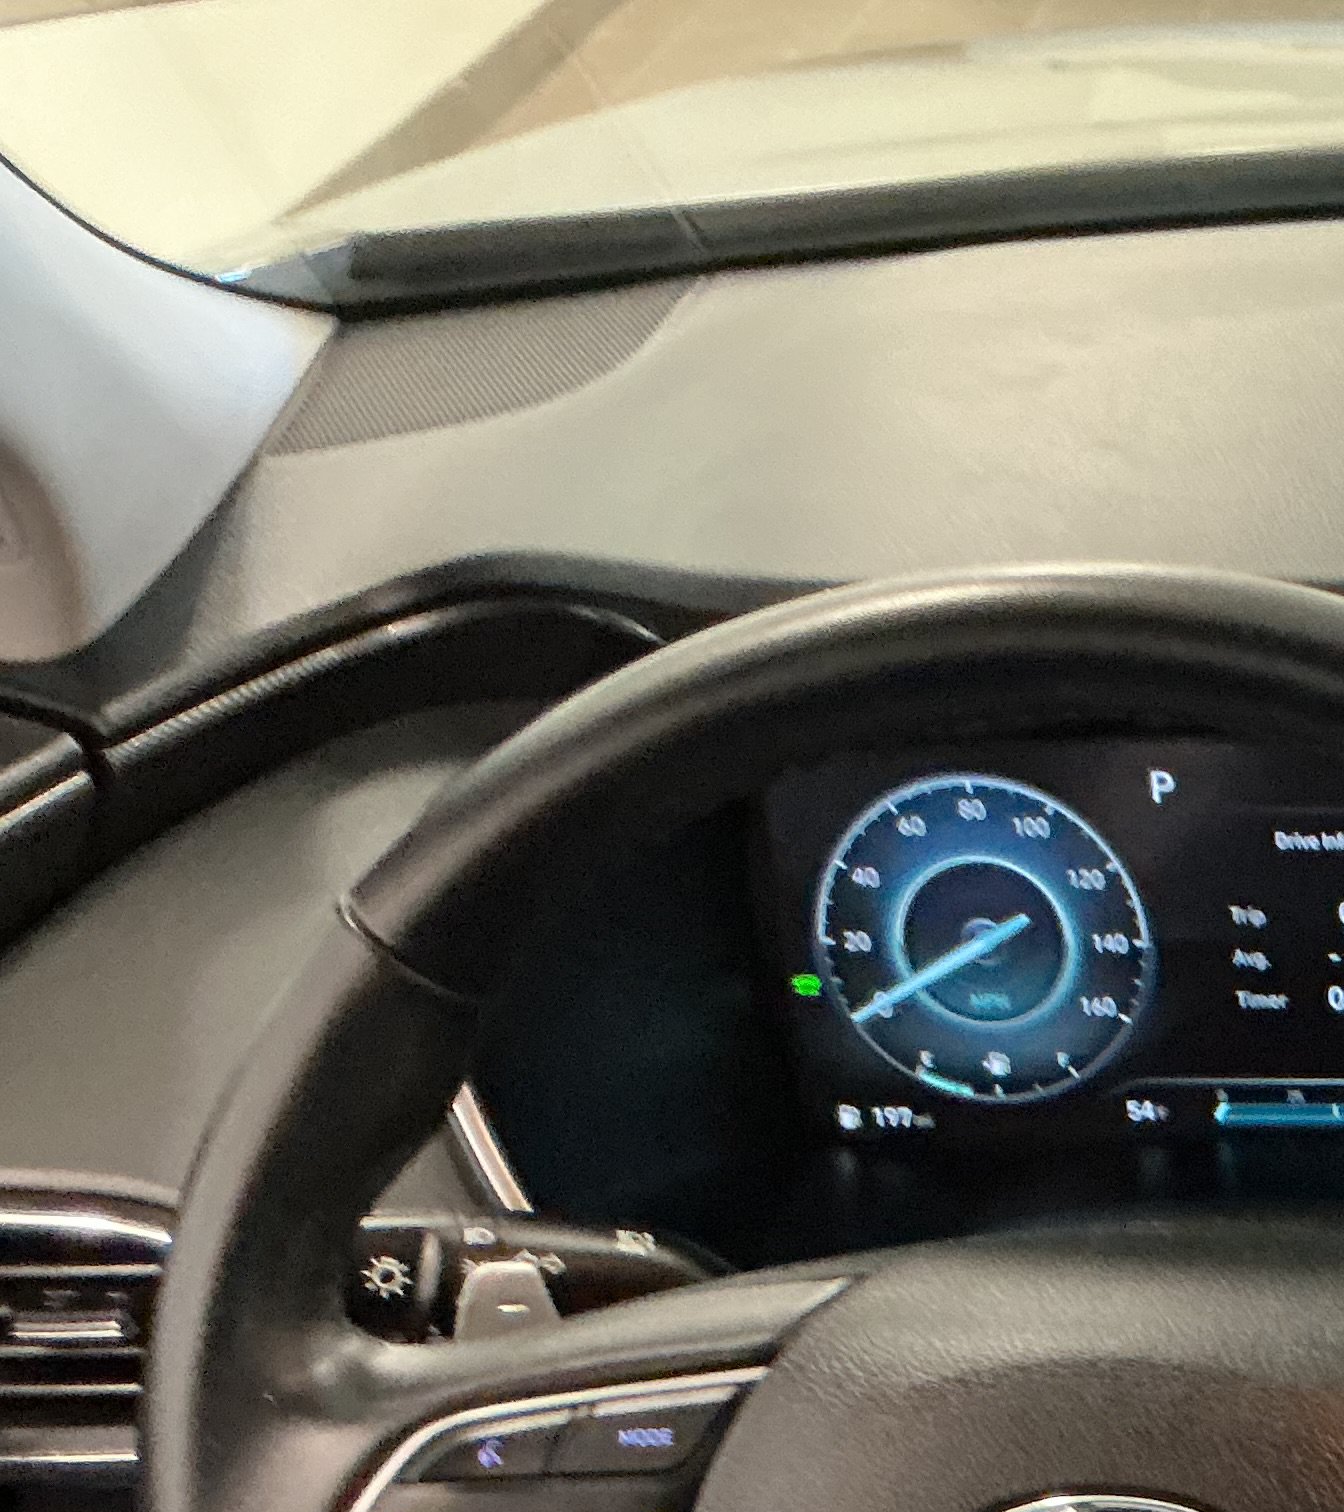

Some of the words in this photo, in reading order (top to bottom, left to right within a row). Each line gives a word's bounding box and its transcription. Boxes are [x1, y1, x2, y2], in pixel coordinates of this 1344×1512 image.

[1149, 769, 1176, 804] P
[957, 798, 987, 821] 80
[897, 815, 927, 837] 60
[1012, 815, 1051, 839] 100
[851, 866, 881, 889] 40
[1066, 868, 1106, 890] 120
[1092, 932, 1130, 955] 140
[1080, 996, 1118, 1018] 160
